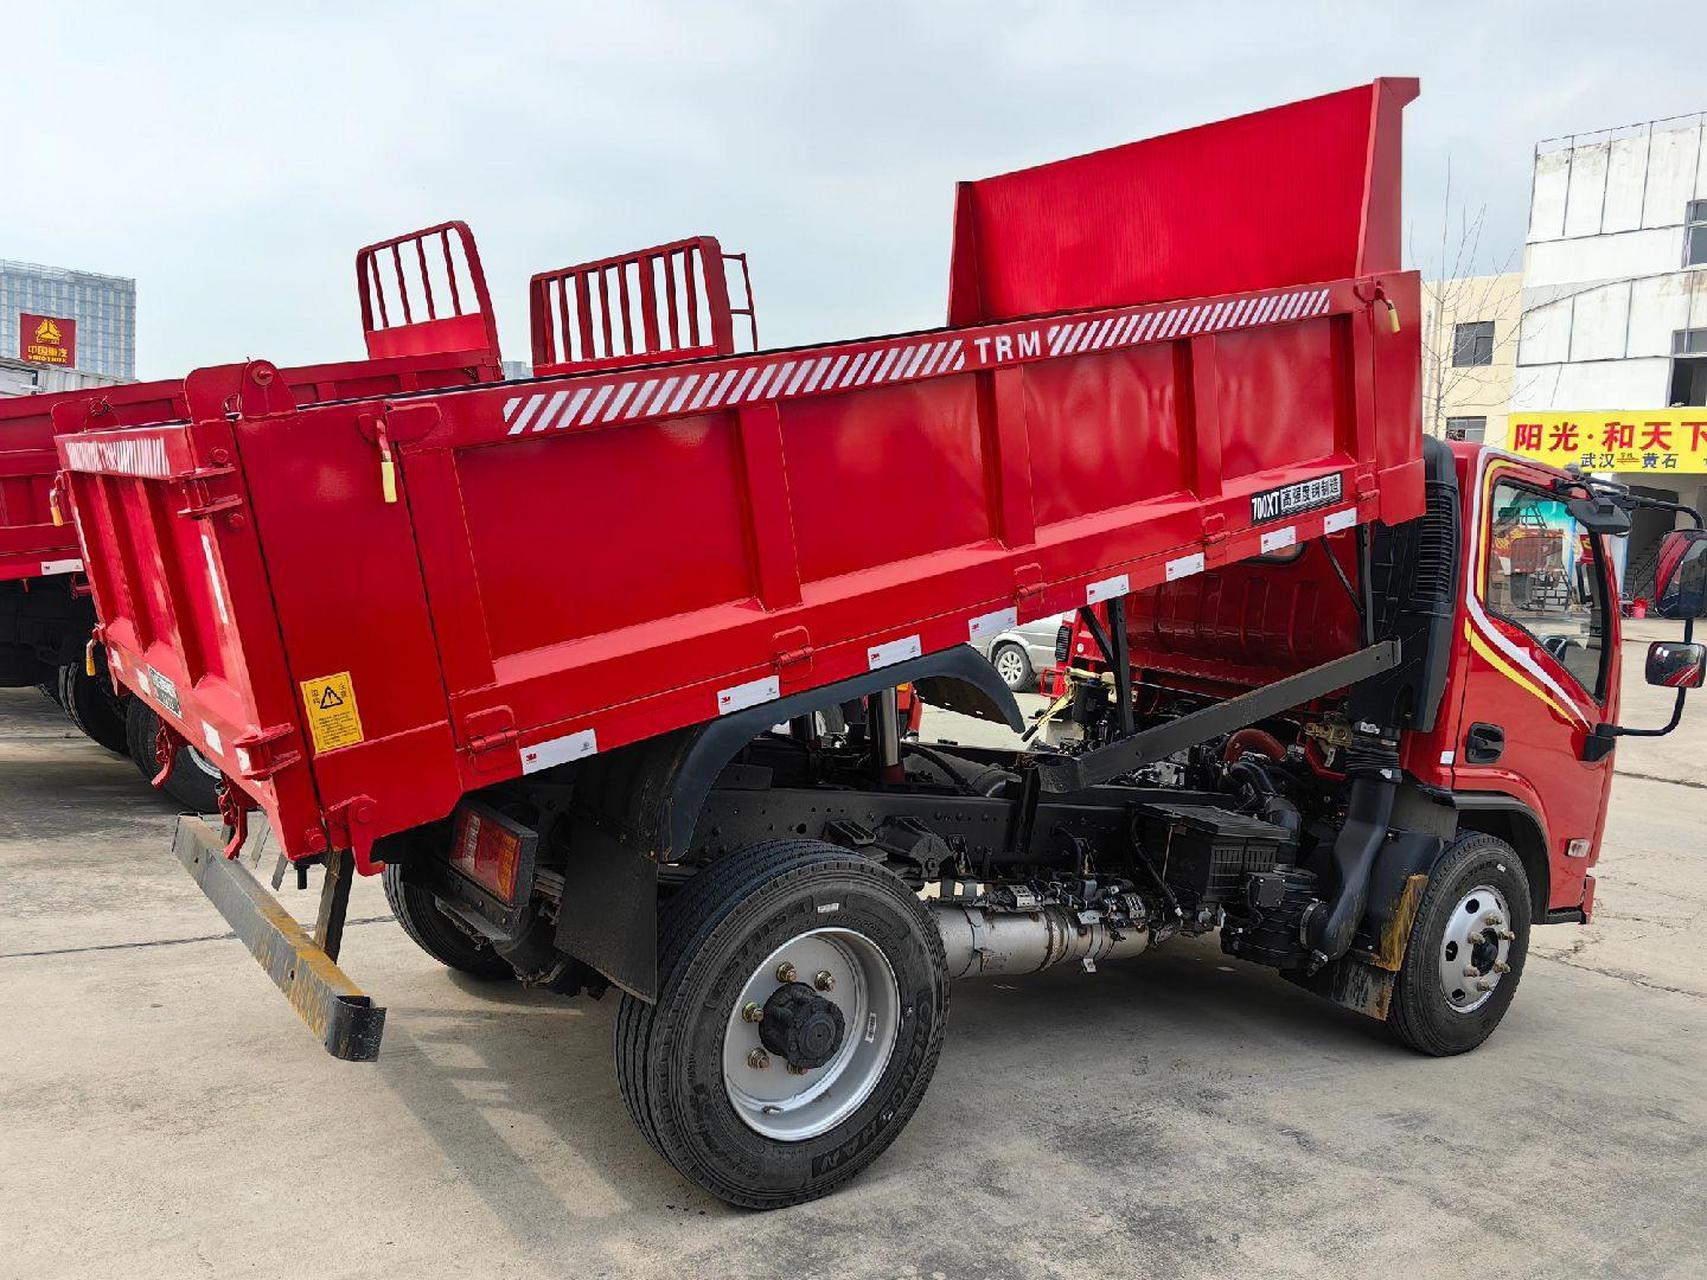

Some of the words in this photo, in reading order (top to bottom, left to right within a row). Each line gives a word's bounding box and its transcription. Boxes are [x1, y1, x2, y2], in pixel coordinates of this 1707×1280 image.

[974, 330, 1041, 364] TRM
[1581, 453, 1615, 469] 武汉
[1642, 453, 1679, 469] 黄石
